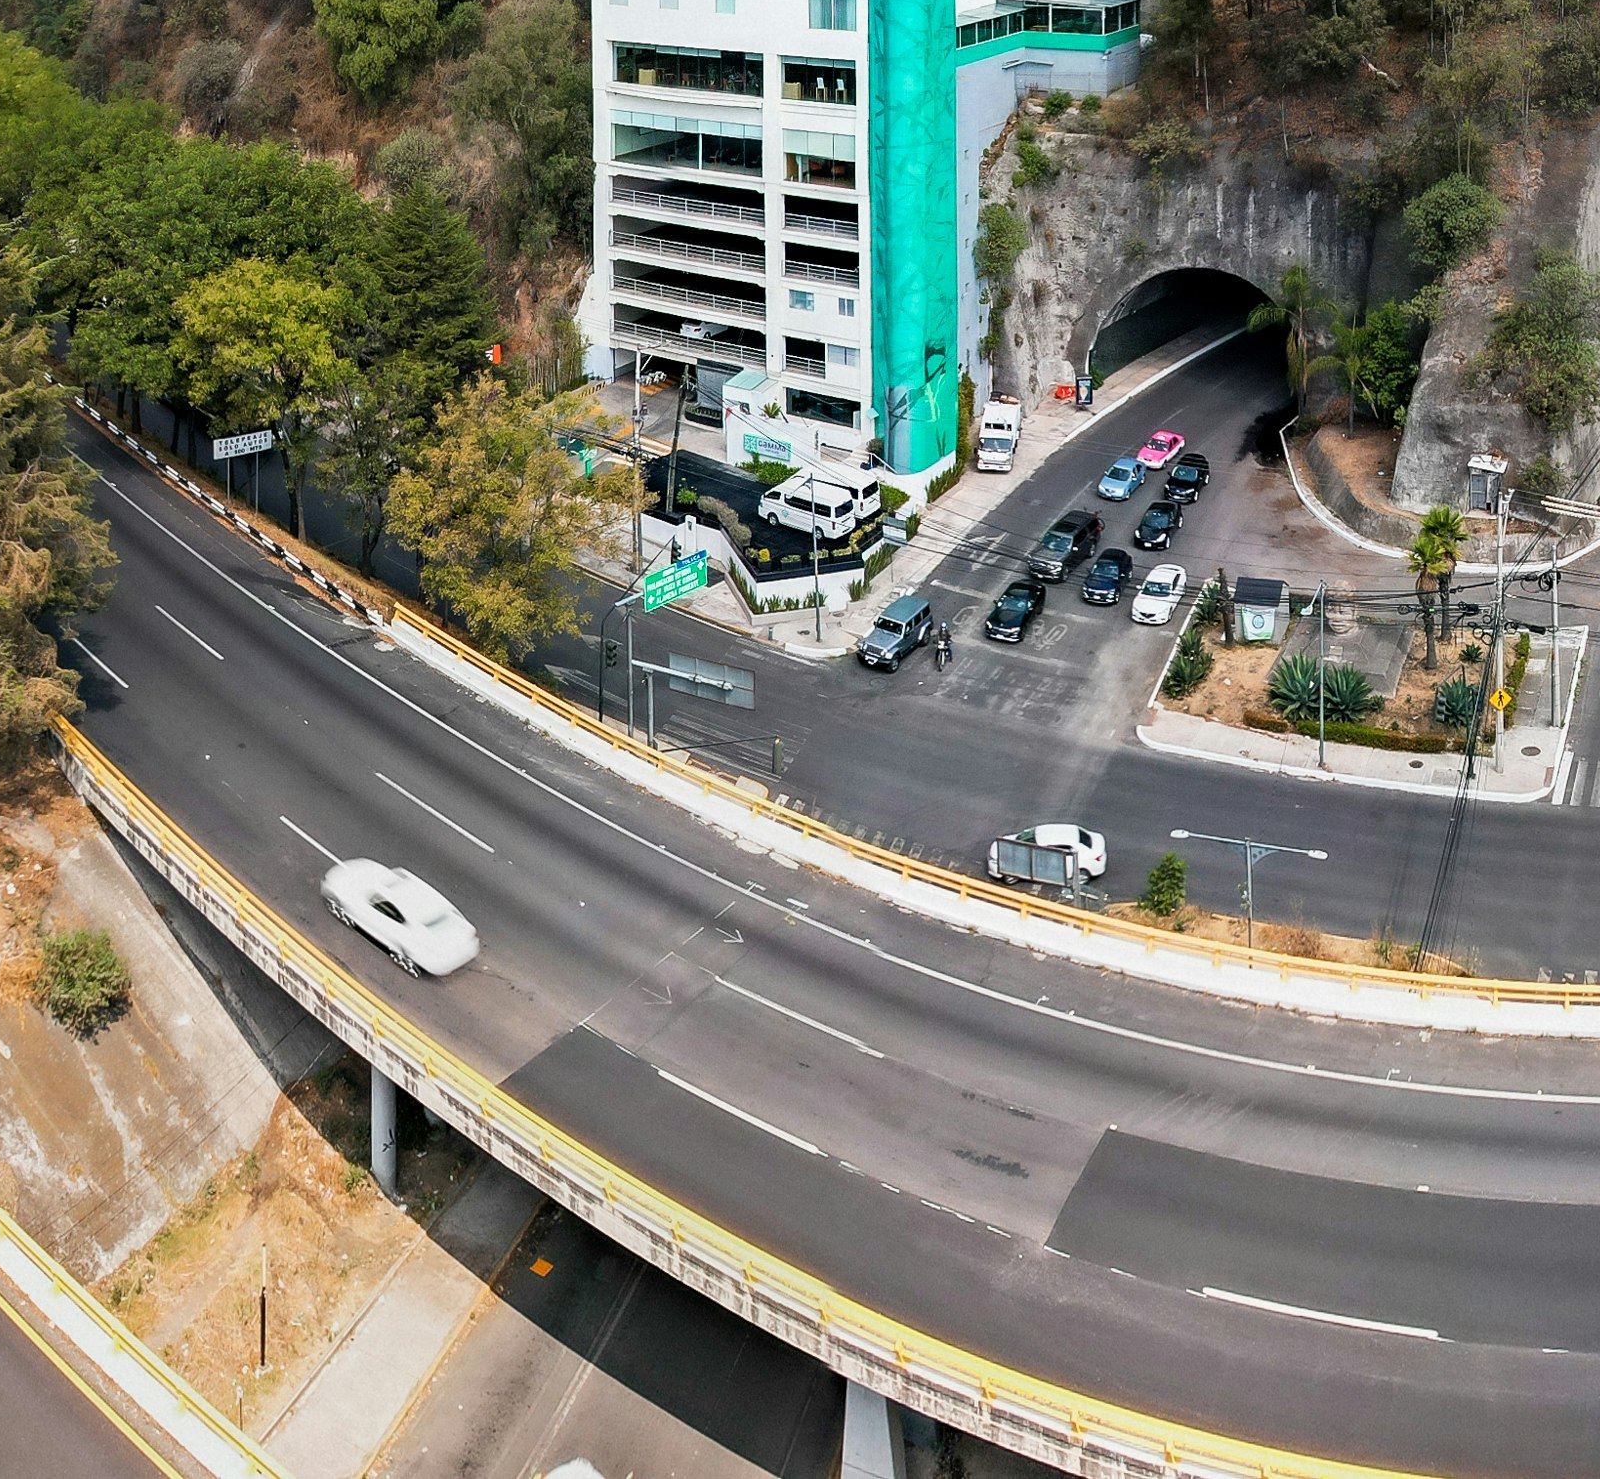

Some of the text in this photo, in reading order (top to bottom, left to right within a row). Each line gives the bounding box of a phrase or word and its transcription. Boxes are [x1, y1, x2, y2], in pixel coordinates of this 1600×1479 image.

[219, 432, 267, 445] TELEPEAJE
[219, 437, 267, 452] SOLO AUTOS
